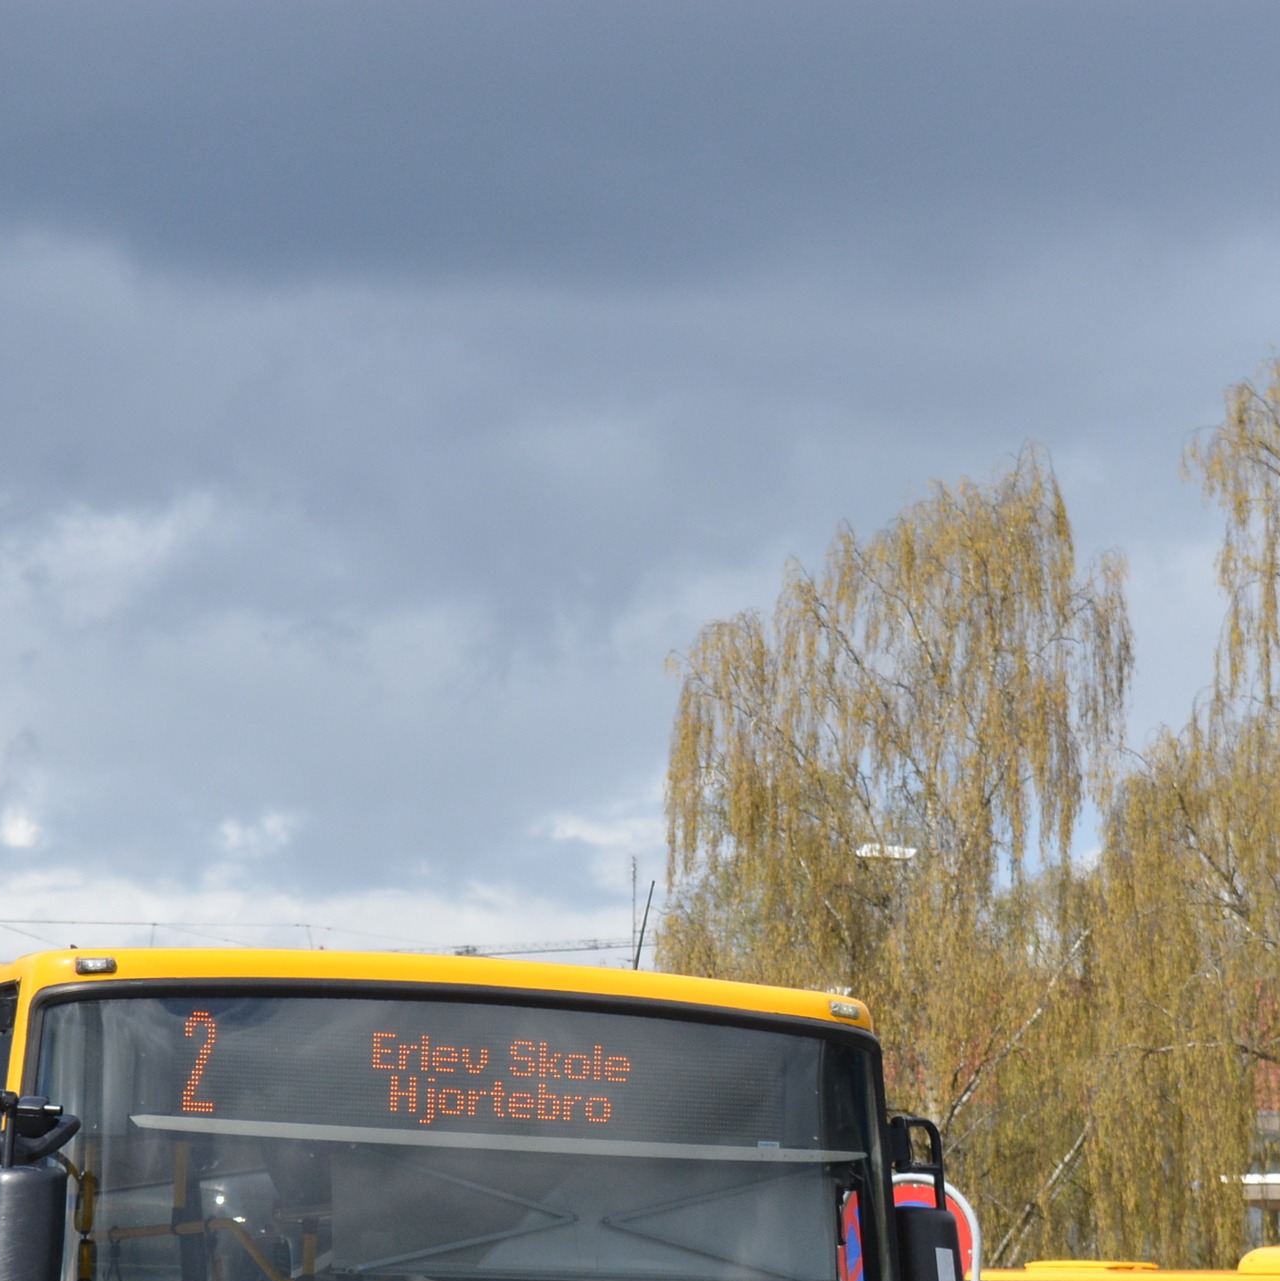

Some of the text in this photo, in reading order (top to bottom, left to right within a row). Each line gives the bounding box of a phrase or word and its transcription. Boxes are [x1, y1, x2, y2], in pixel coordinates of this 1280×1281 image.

[183, 1011, 216, 1112] 2
[372, 1032, 631, 1082] Erlev Skole
[389, 1075, 611, 1124] Hjortebro
